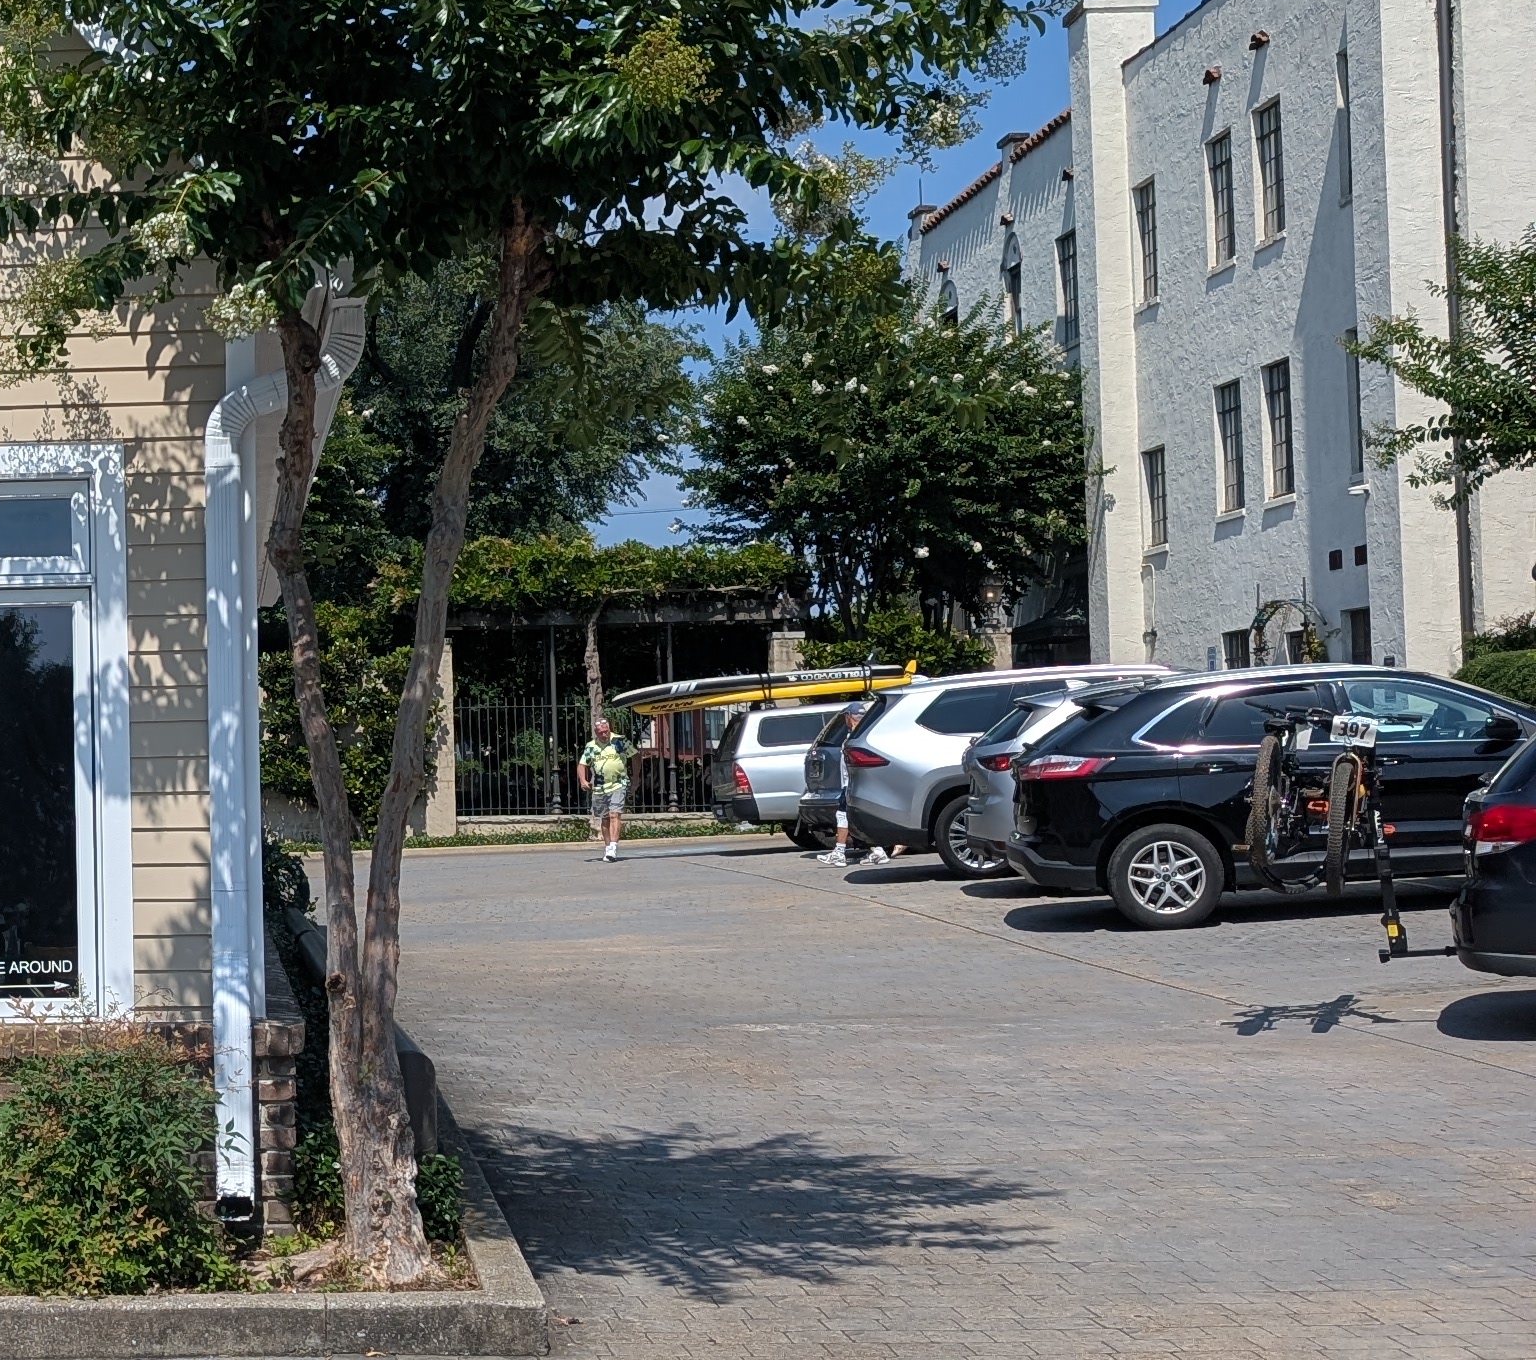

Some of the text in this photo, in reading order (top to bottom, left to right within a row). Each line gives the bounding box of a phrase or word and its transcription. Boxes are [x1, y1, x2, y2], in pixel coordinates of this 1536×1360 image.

[1337, 721, 1371, 740] 397
[1374, 810, 1385, 844] ALLEN
[8, 960, 73, 975] AROUND
